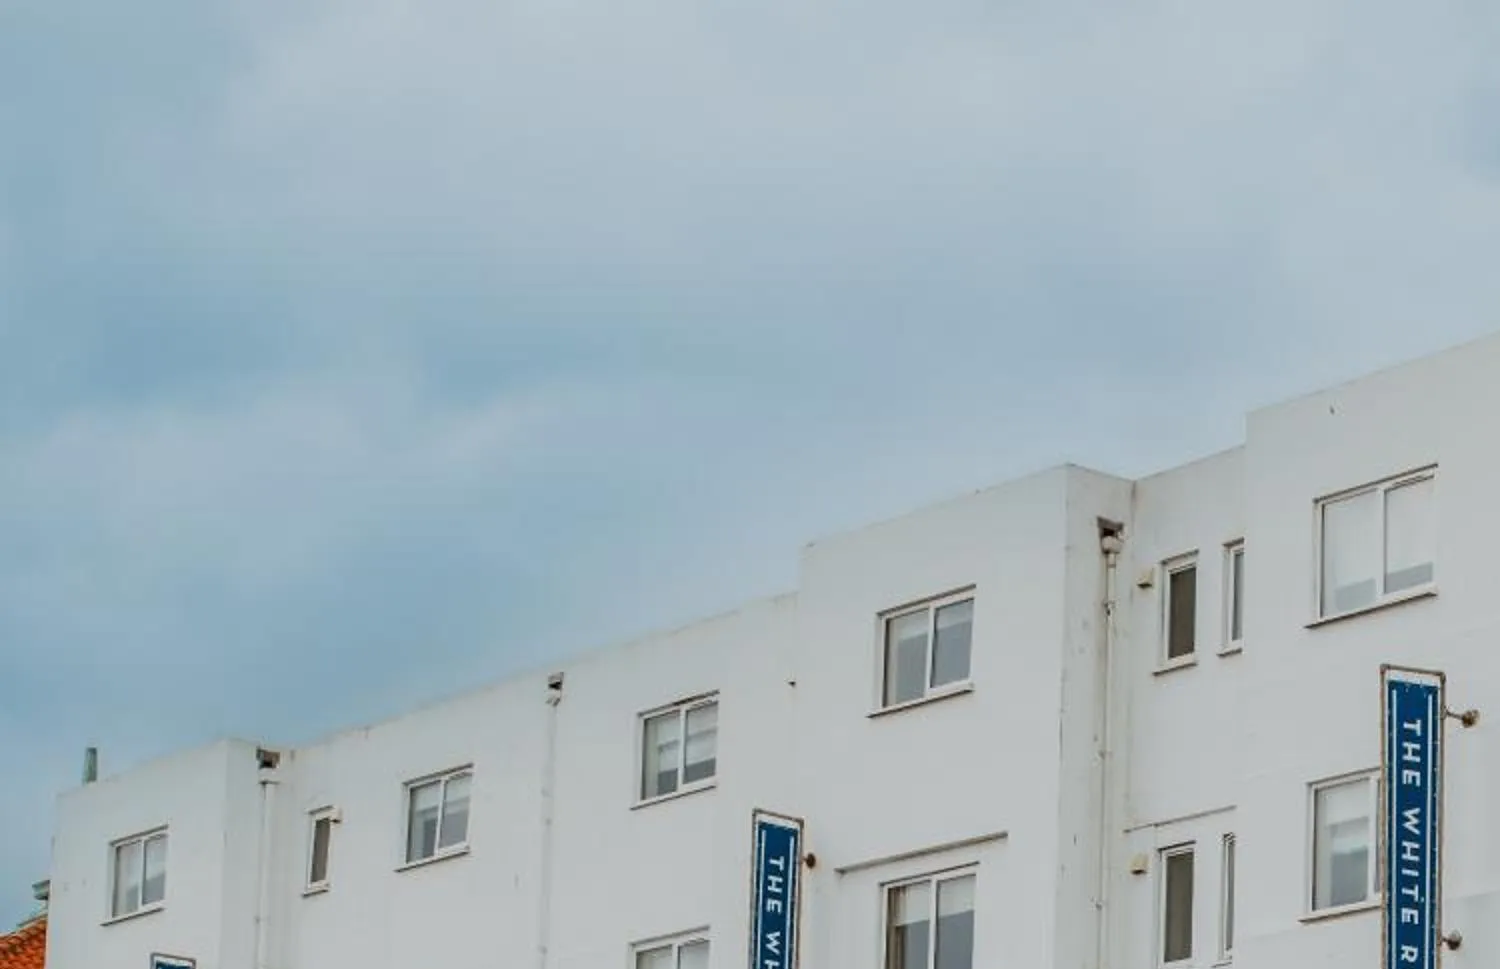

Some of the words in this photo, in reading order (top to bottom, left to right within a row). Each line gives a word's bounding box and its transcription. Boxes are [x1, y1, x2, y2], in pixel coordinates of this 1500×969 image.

[1403, 719, 1421, 786] THE
[767, 857, 784, 913] THE
[1401, 807, 1420, 925] WHITE
